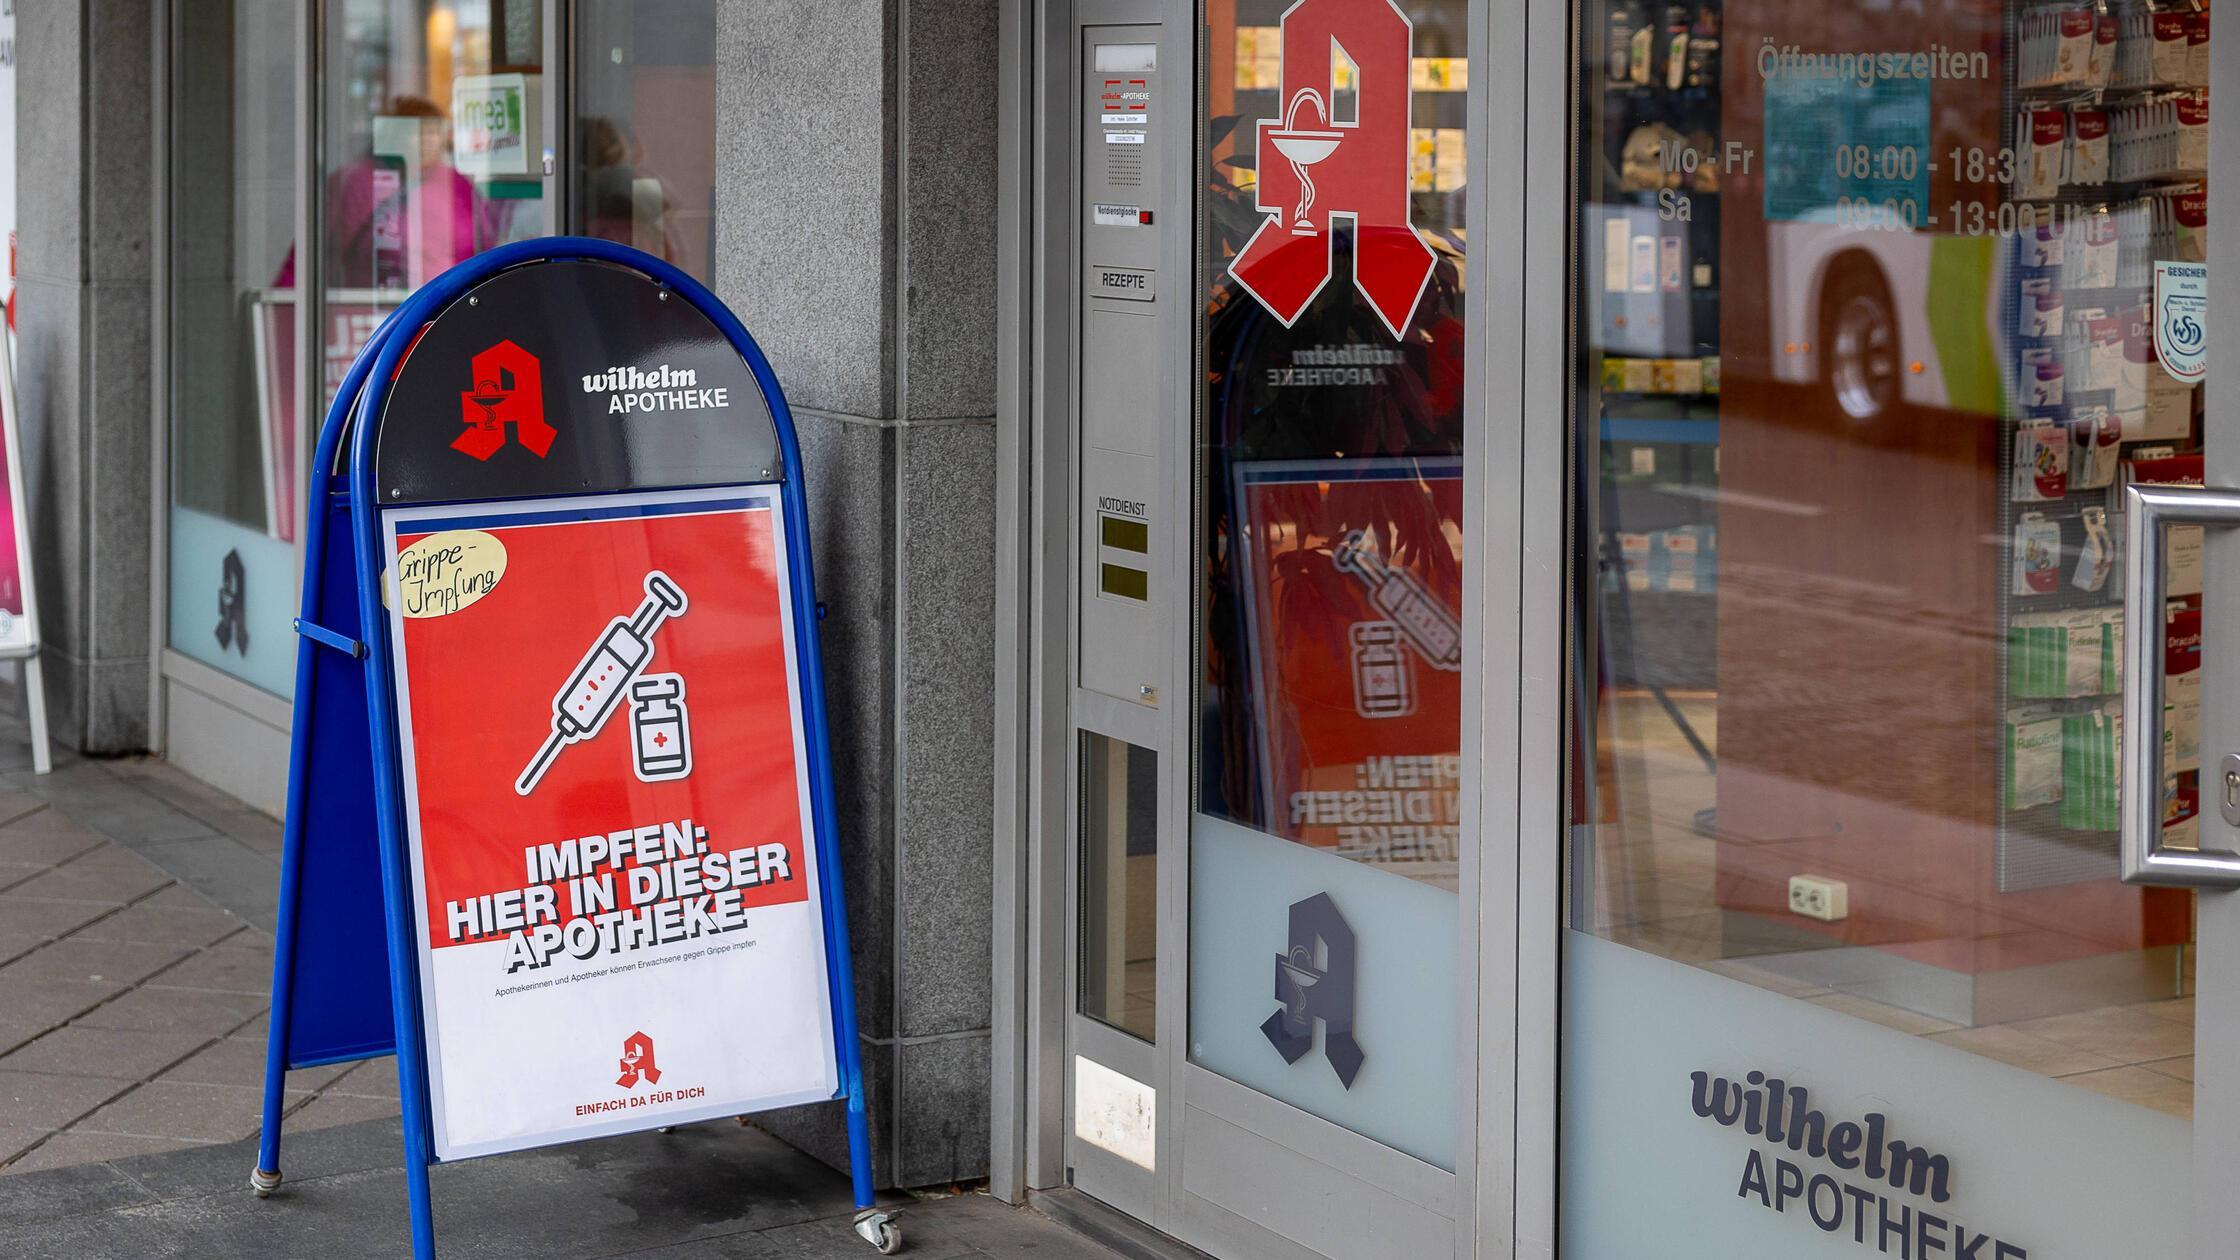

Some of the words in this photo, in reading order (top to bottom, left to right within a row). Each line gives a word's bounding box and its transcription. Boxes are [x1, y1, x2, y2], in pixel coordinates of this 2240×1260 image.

[1757, 37, 1988, 88] Öffnungszeiten
[1659, 139, 1698, 173] Mo
[1725, 141, 1753, 175] Fr
[1835, 145, 1918, 181] 08:00
[1098, 206, 1137, 218] Notdienstglocke
[1658, 187, 1692, 222] Sa
[1835, 195, 1919, 234] 09:00
[1950, 200, 2036, 239] 13:00
[1102, 272, 1145, 289] REZEPTE
[582, 364, 697, 393] wilhelm
[608, 387, 729, 415] APOTHEKE
[1099, 496, 1146, 516] NOTDIENST
[525, 818, 711, 885] IMPFEN:
[446, 884, 561, 943] HIER
[569, 872, 618, 918] IN
[627, 842, 794, 908] DIESER
[502, 888, 748, 975] APOTHEKE
[494, 977, 553, 997] Apothekerinnen
[554, 974, 569, 985] und
[570, 966, 608, 983] Apotheker
[609, 962, 636, 975] können
[637, 953, 682, 970] Erwachsene
[683, 949, 705, 962] gegen
[706, 943, 731, 957] Grippe
[732, 938, 756, 952] impfen
[576, 1099, 626, 1116] EINFACH
[630, 1096, 646, 1108] DA
[650, 1091, 673, 1105] FÜR
[677, 1087, 705, 1100] DICH
[1690, 1070, 1950, 1203] wilhelm
